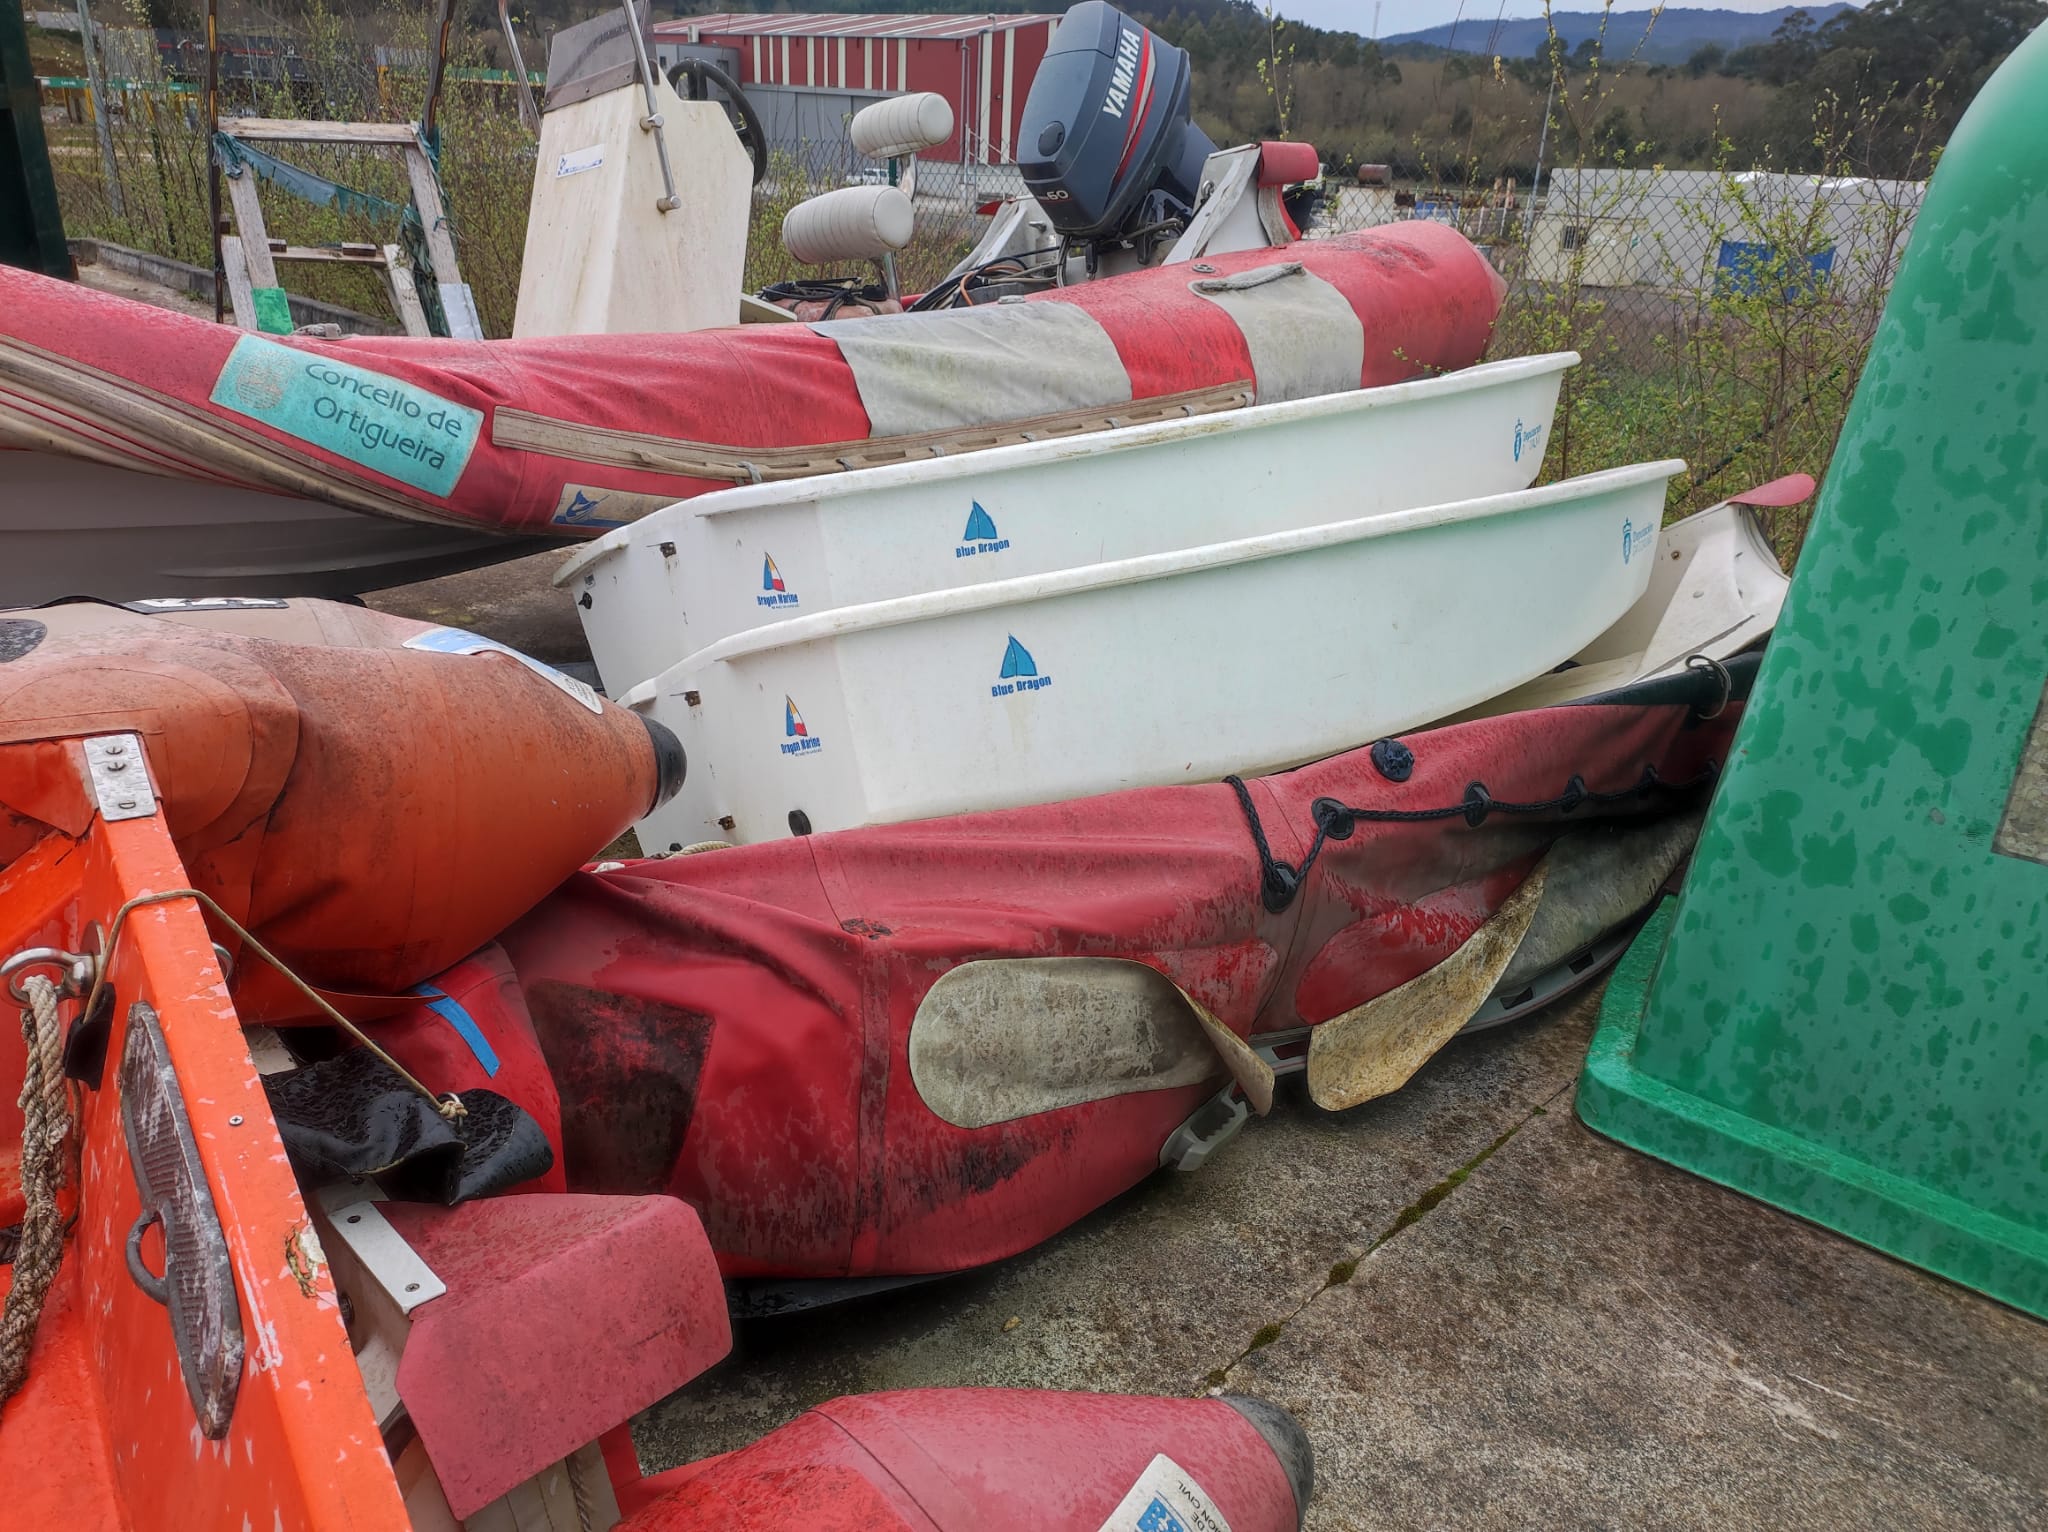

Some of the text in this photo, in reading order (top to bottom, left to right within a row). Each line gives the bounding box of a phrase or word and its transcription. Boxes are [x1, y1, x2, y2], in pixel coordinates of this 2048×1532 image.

[1102, 27, 1141, 119] YAMAHA
[304, 363, 463, 439] Concello de
[313, 396, 446, 471] Ortigueira
[956, 539, 1010, 558] Blue Dragon
[991, 675, 1052, 697] Blue Dragon
[1177, 1479, 1201, 1510] CIVIL
[1190, 1511, 1206, 1532] DE
